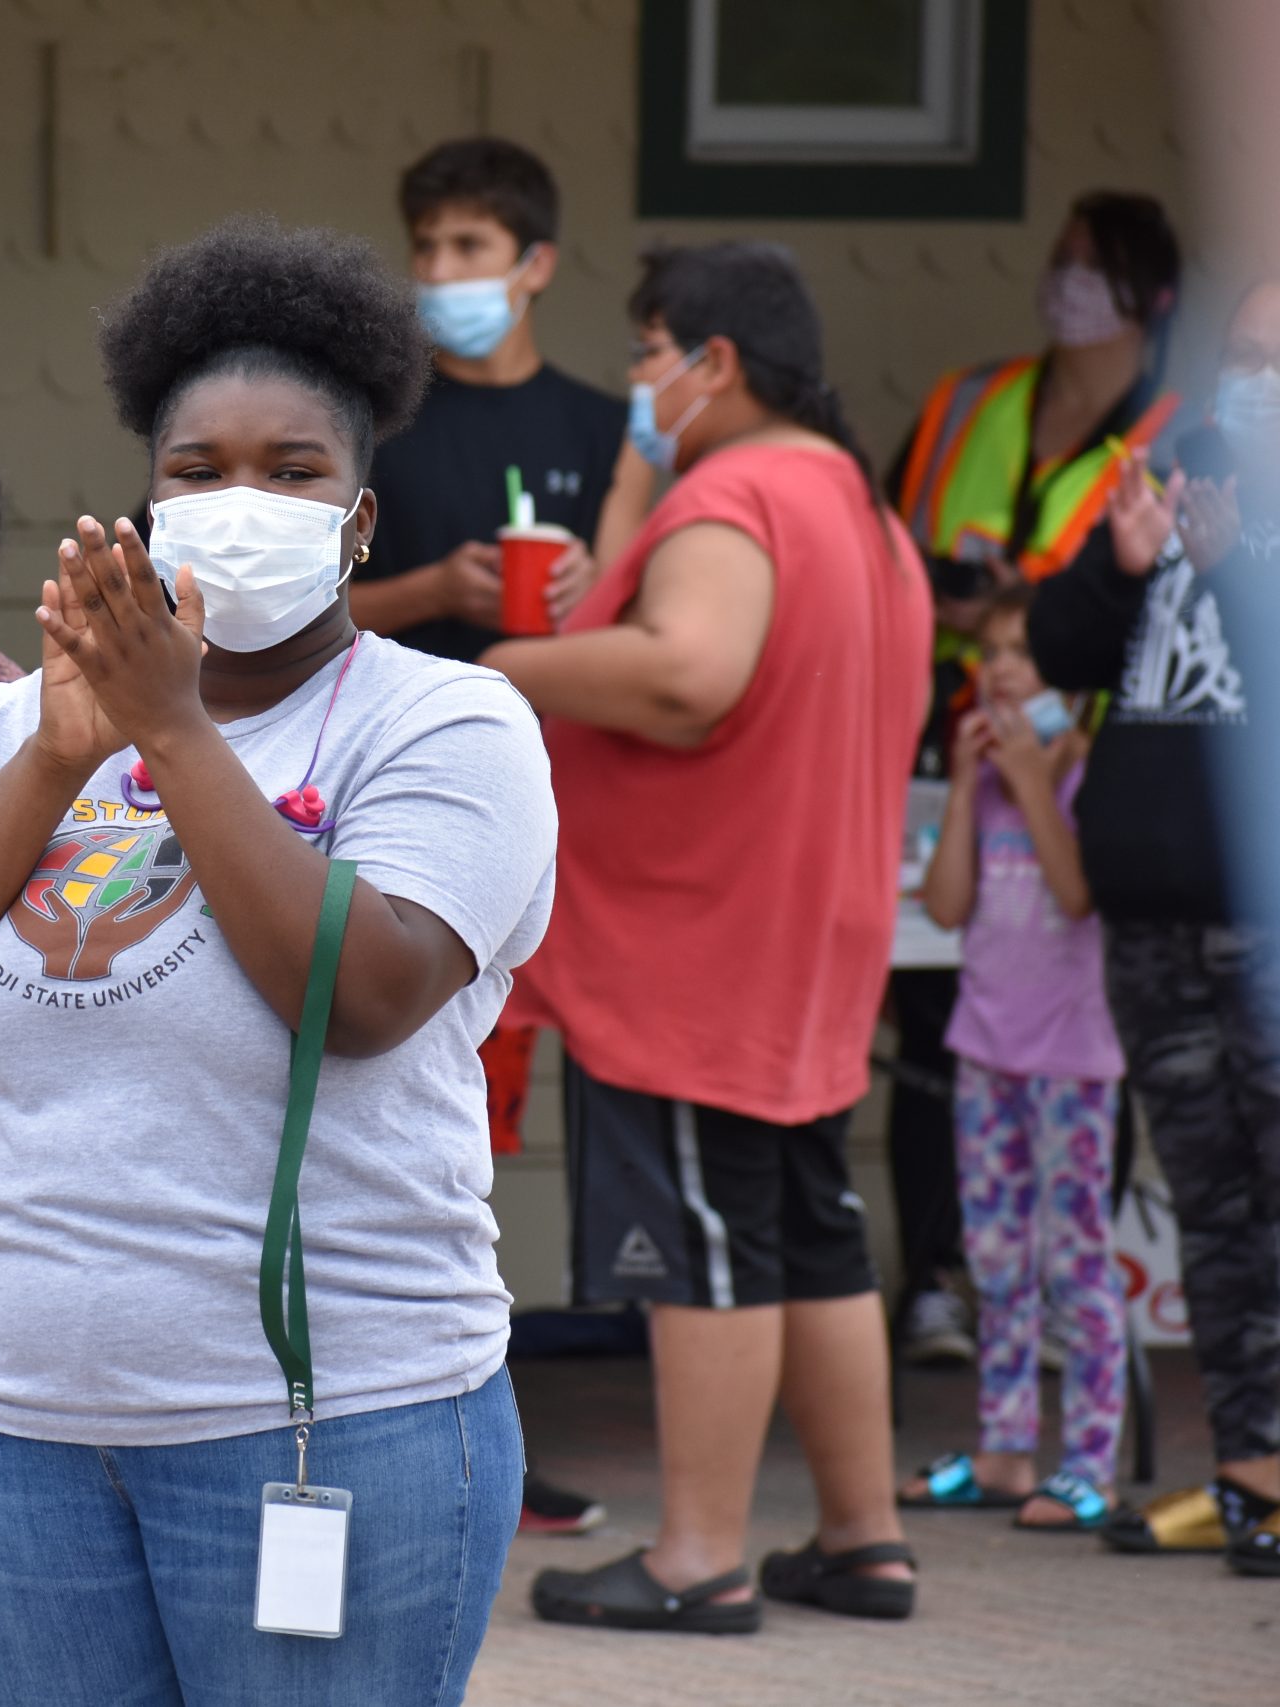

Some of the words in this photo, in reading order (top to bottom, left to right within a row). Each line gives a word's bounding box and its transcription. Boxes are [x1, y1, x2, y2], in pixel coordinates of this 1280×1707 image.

[72, 799, 166, 821] STU
[22, 983, 86, 1009] STATE
[93, 928, 206, 1007] UNIVERSITY
